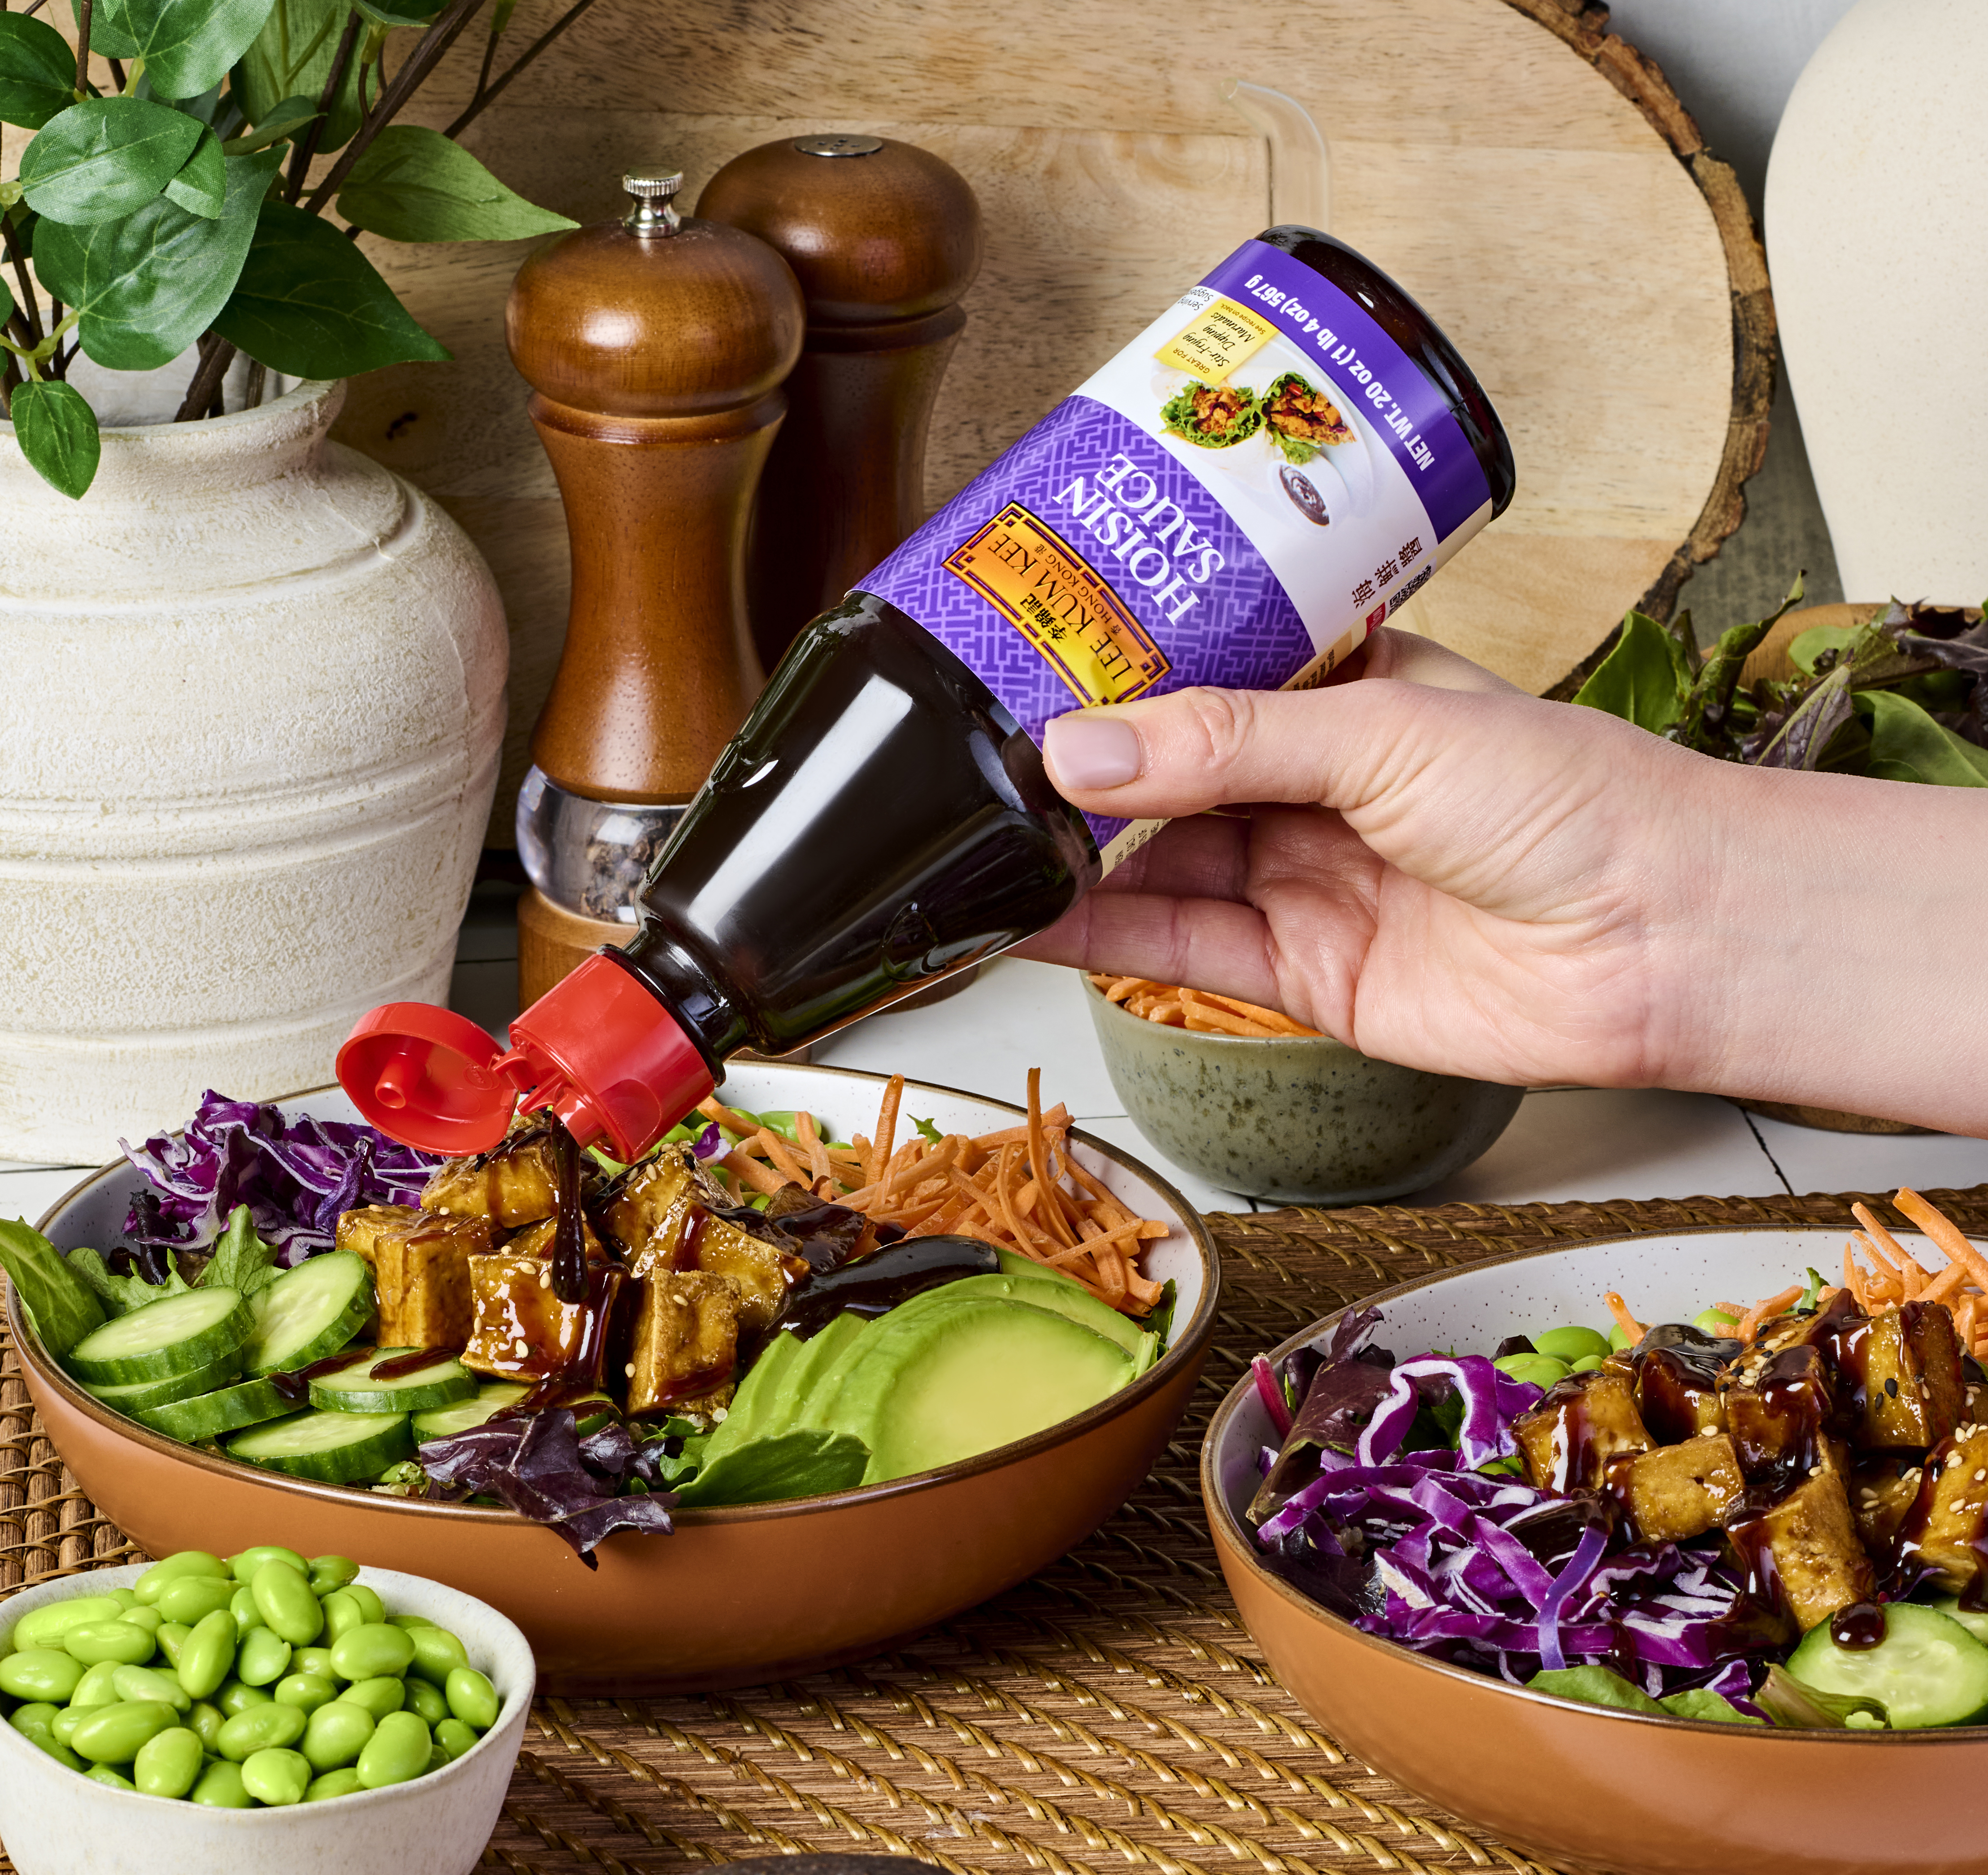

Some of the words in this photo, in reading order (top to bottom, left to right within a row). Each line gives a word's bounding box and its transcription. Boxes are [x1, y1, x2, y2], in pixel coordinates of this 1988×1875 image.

[1177, 297, 1203, 310] Serving
[1279, 297, 1309, 322] oz)
[1211, 312, 1255, 342] Marinades
[1239, 314, 1256, 327] recipe
[1255, 325, 1266, 335] See
[1302, 318, 1320, 332] 4
[1183, 332, 1230, 366] Stir-Frying
[1203, 324, 1235, 351] Dipping
[1317, 329, 1338, 350] lb
[1173, 348, 1188, 358] FOR
[1186, 357, 1210, 373] GREAT
[1331, 344, 1356, 365] (1
[1349, 360, 1372, 384] oz
[1365, 382, 1392, 409] 20
[1384, 402, 1413, 440] WT.
[1404, 435, 1435, 471] NET
[1095, 453, 1225, 583] SAUCE
[987, 532, 1039, 577] KEE
[1034, 543, 1047, 556] 港
[1052, 476, 1200, 626] HOISIN
[1045, 554, 1080, 587] KONG
[1352, 536, 1422, 609] 海鮮醬
[1033, 568, 1097, 637] KUM
[1078, 586, 1112, 624] HONG
[1020, 593, 1067, 643] 李錦記
[1110, 624, 1122, 636] 香
[1089, 631, 1134, 683] LEE
